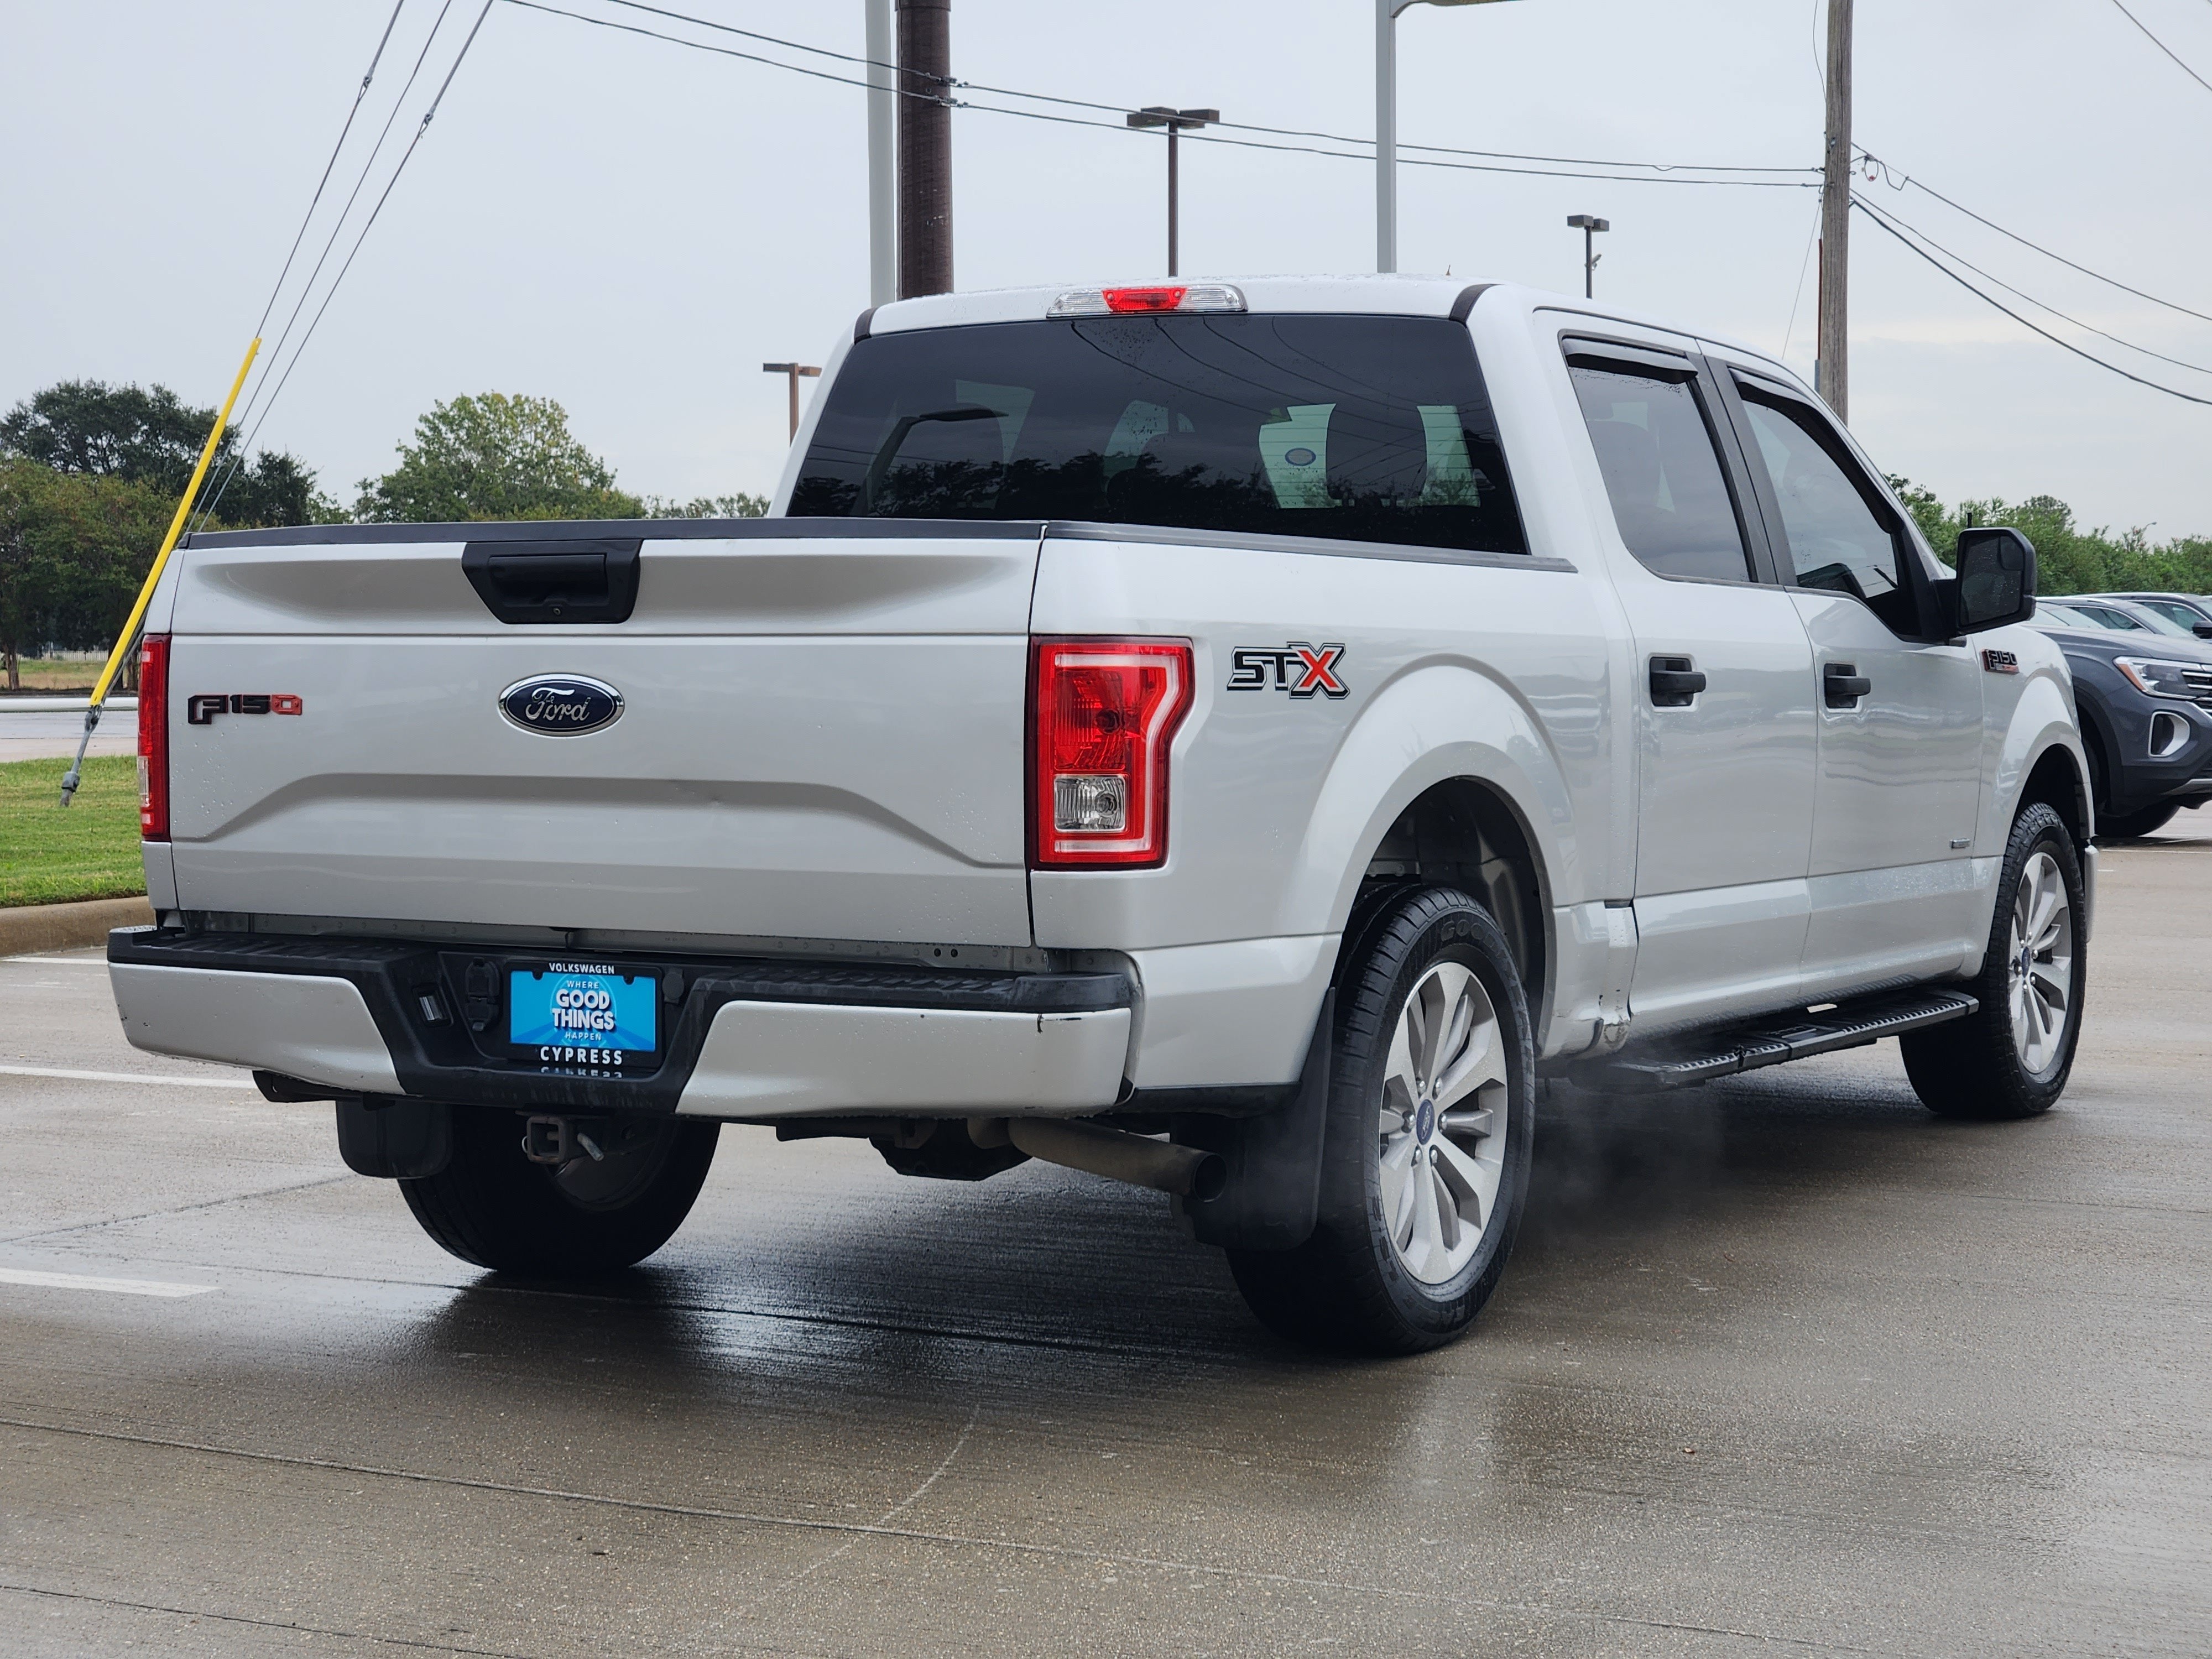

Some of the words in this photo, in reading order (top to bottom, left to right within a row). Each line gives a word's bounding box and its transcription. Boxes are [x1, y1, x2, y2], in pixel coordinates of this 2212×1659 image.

[1227, 641, 1350, 700] STX
[188, 695, 302, 724] F150
[525, 687, 591, 721] Ford
[549, 962, 615, 974] VOLKSWAGEN
[566, 980, 599, 989] WHERE
[556, 988, 610, 1009] GOOD
[551, 1008, 614, 1030] THINGS
[565, 1032, 601, 1041] HAPPEN
[540, 1046, 622, 1065] CYPRESS
